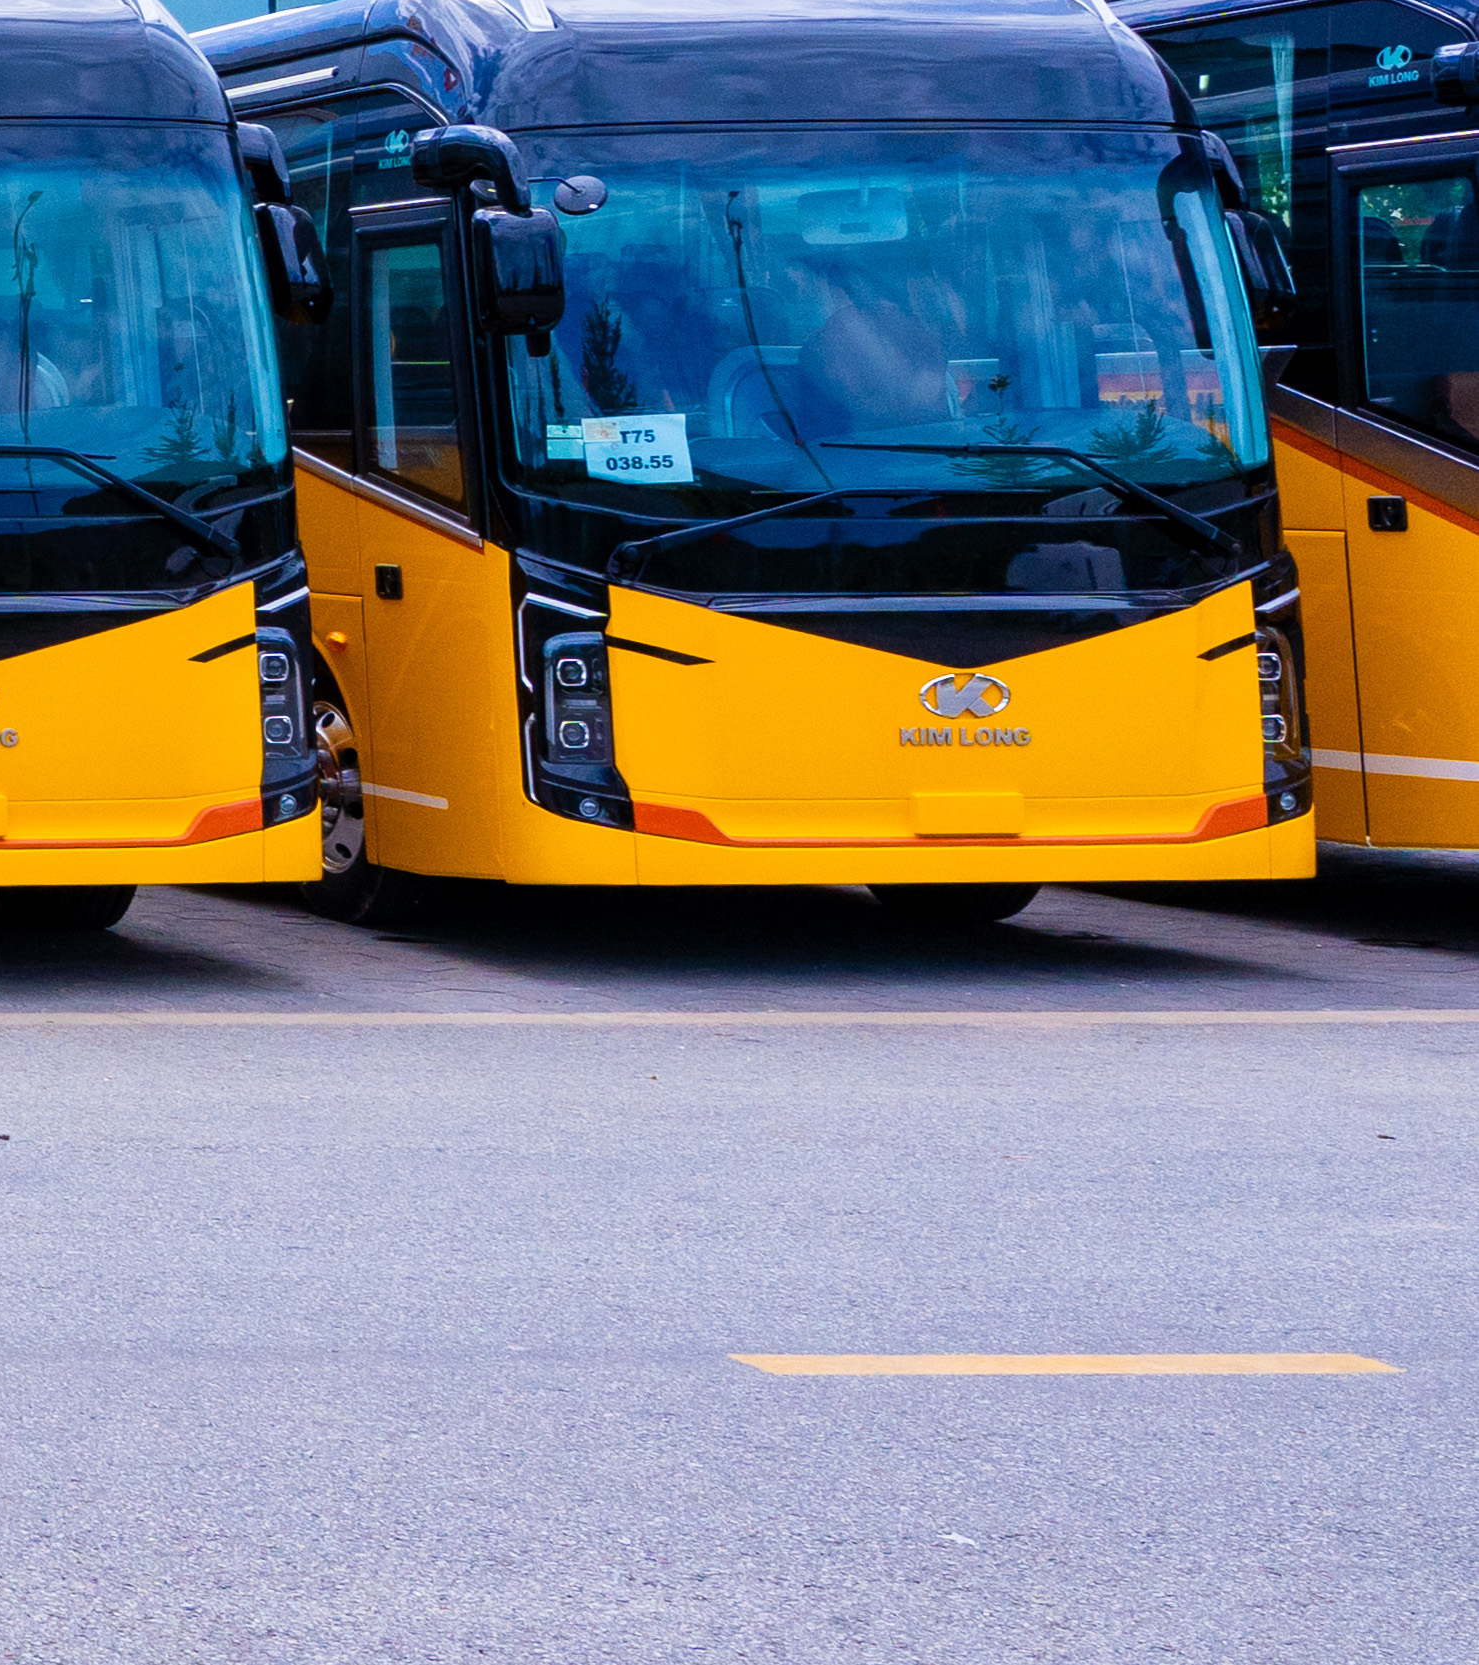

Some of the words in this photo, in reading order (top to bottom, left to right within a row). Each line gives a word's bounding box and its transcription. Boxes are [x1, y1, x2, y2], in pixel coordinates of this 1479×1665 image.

[1368, 74, 1390, 88] KIM
[1390, 69, 1420, 85] LONG
[619, 429, 656, 444] T75
[606, 454, 674, 471] 038.55
[900, 727, 953, 746] KIM
[959, 727, 1031, 746] LONG
